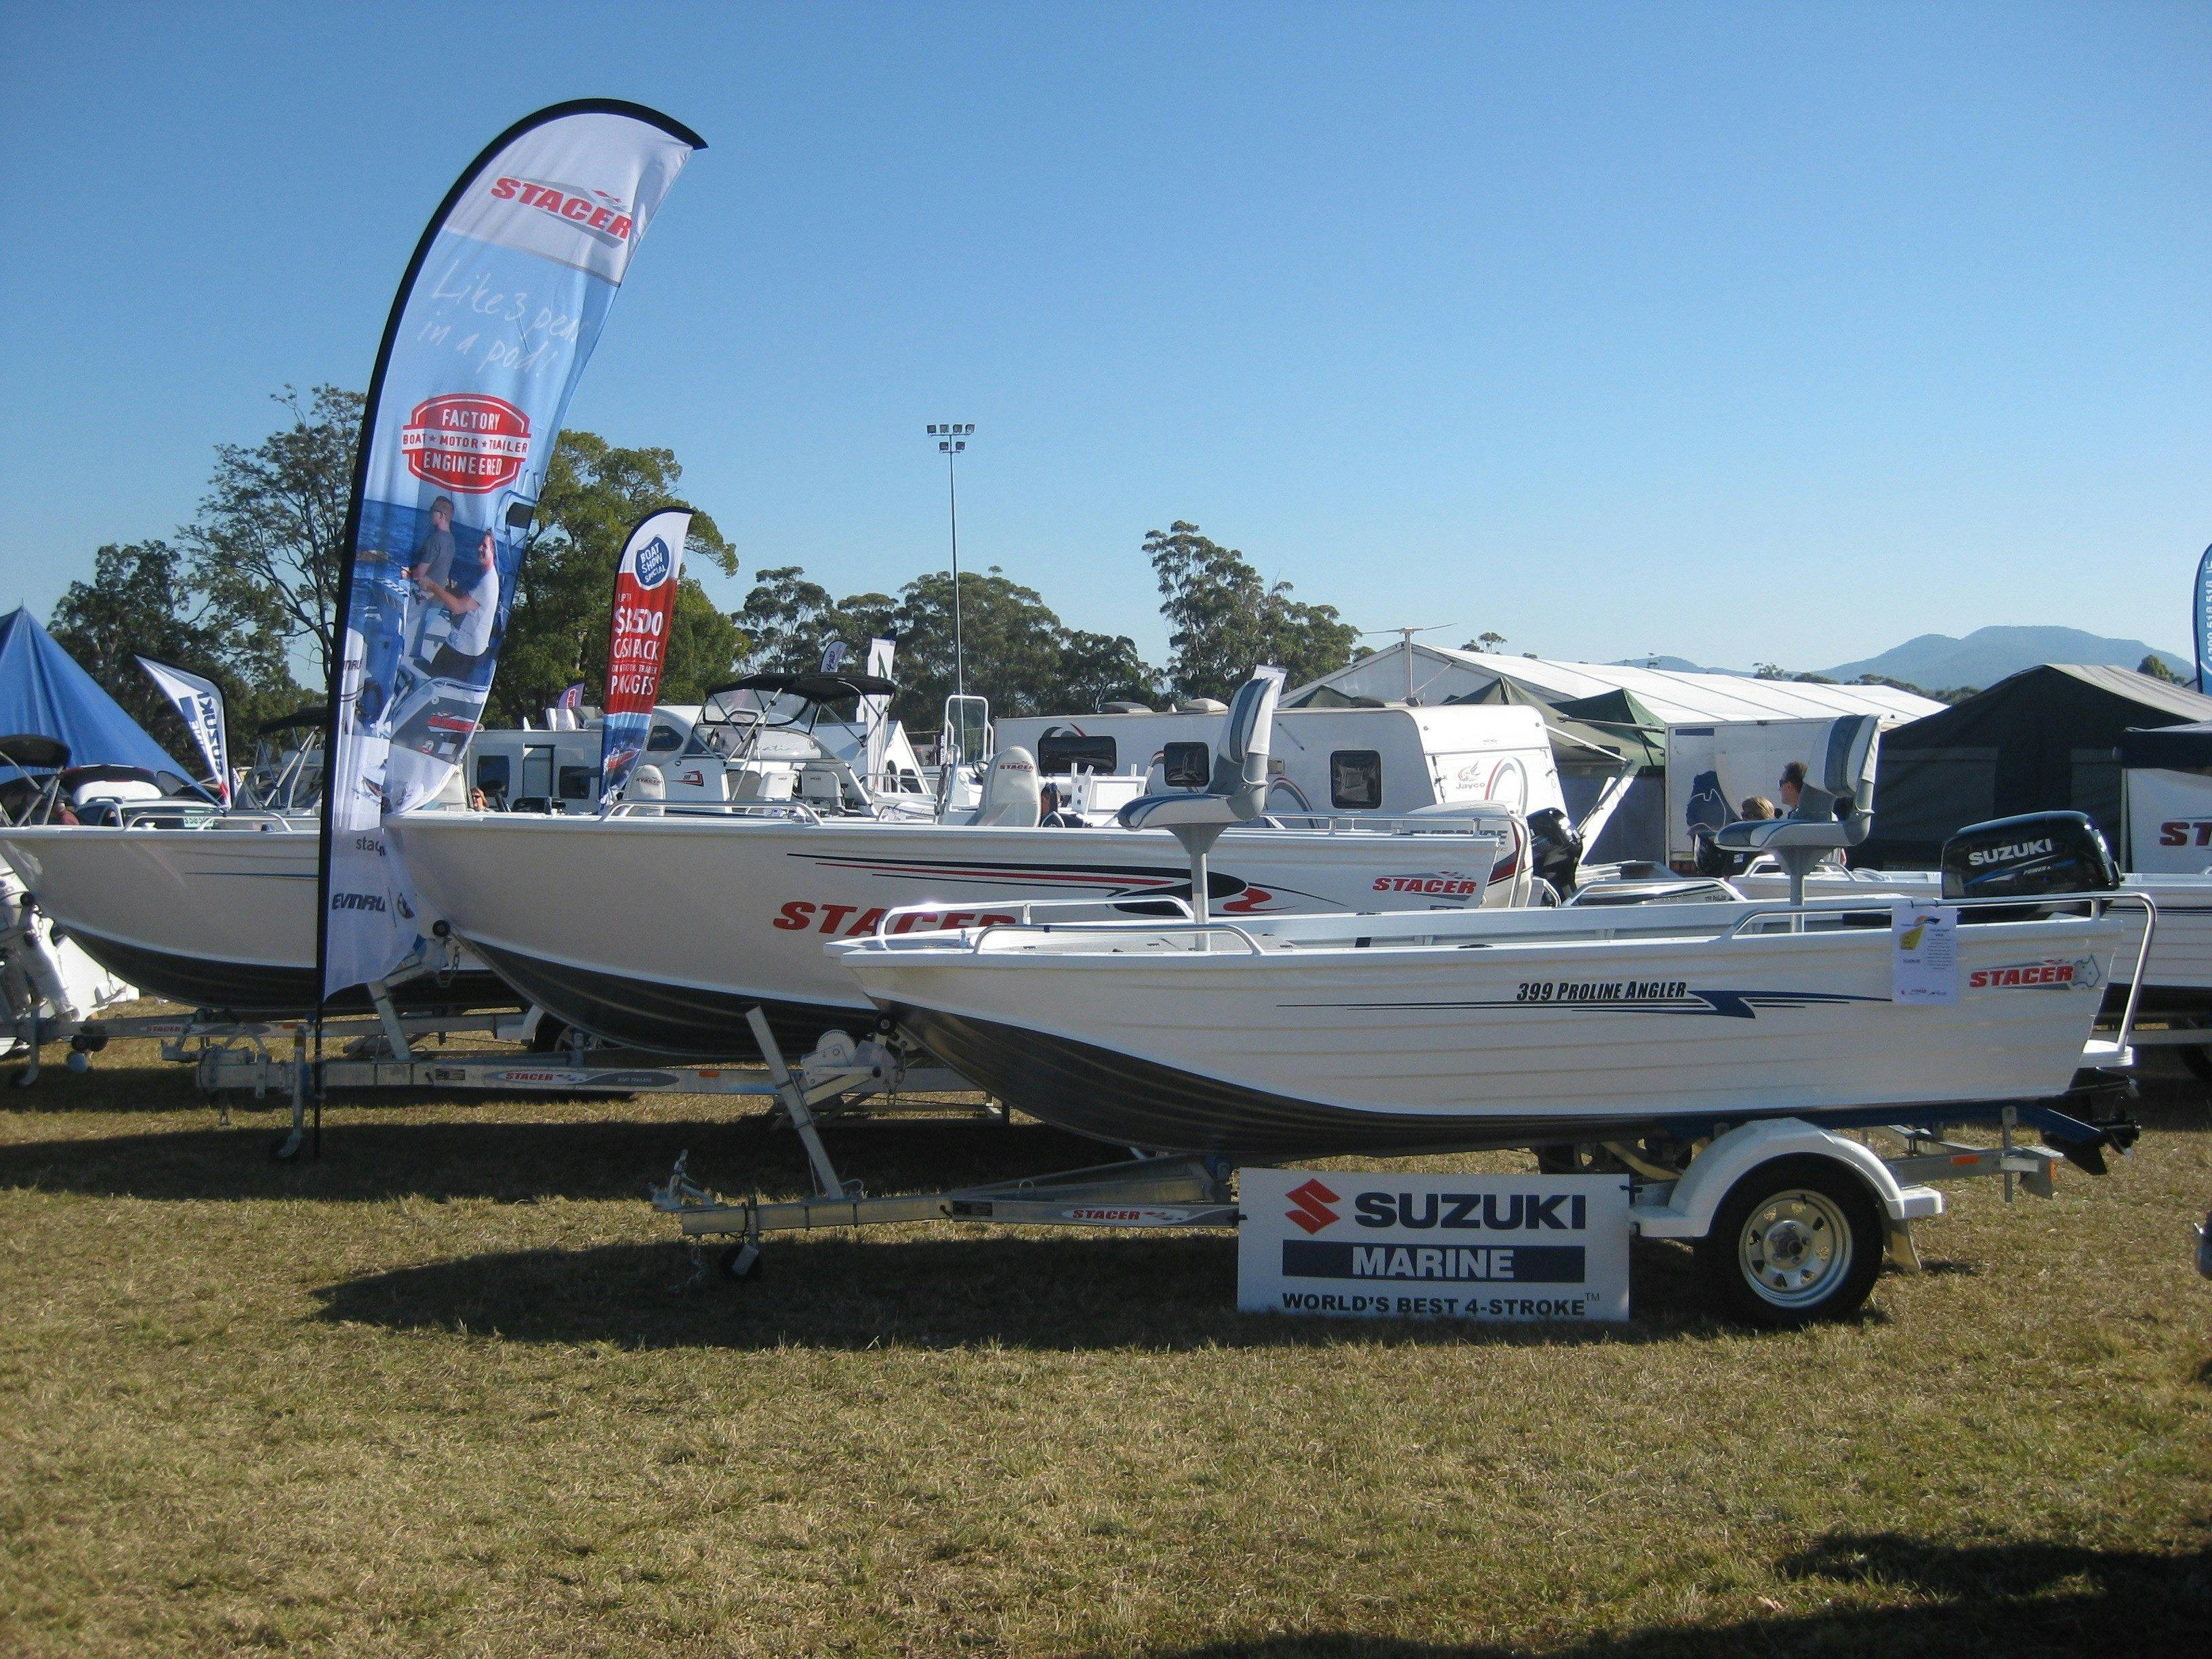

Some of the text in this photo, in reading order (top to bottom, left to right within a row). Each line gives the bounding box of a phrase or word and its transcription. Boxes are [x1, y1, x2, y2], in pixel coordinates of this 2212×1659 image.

[491, 178, 633, 239] STACER
[431, 260, 504, 314] Like
[442, 409, 500, 431] FACTORY
[403, 434, 528, 453] BOAT MOTOR TRAILER
[424, 451, 502, 476] ENGINEERED
[640, 542, 659, 563] BOAT
[642, 553, 663, 573] SHOW
[1968, 838, 2053, 866] SUZUKI
[1372, 877, 1477, 895] STACER
[1969, 965, 2074, 987] STACER
[1517, 980, 1687, 1000] 399 PROLINE ANGLER
[506, 1073, 554, 1081] STACER
[1073, 1209, 1141, 1221] STACER
[1355, 1192, 1586, 1229] SUZUKI
[1352, 1247, 1515, 1278] MARINE
[1282, 1292, 1389, 1313] WORLD'S
[1397, 1297, 1458, 1315] BEST
[1465, 1298, 1584, 1316] 4-STROKE
